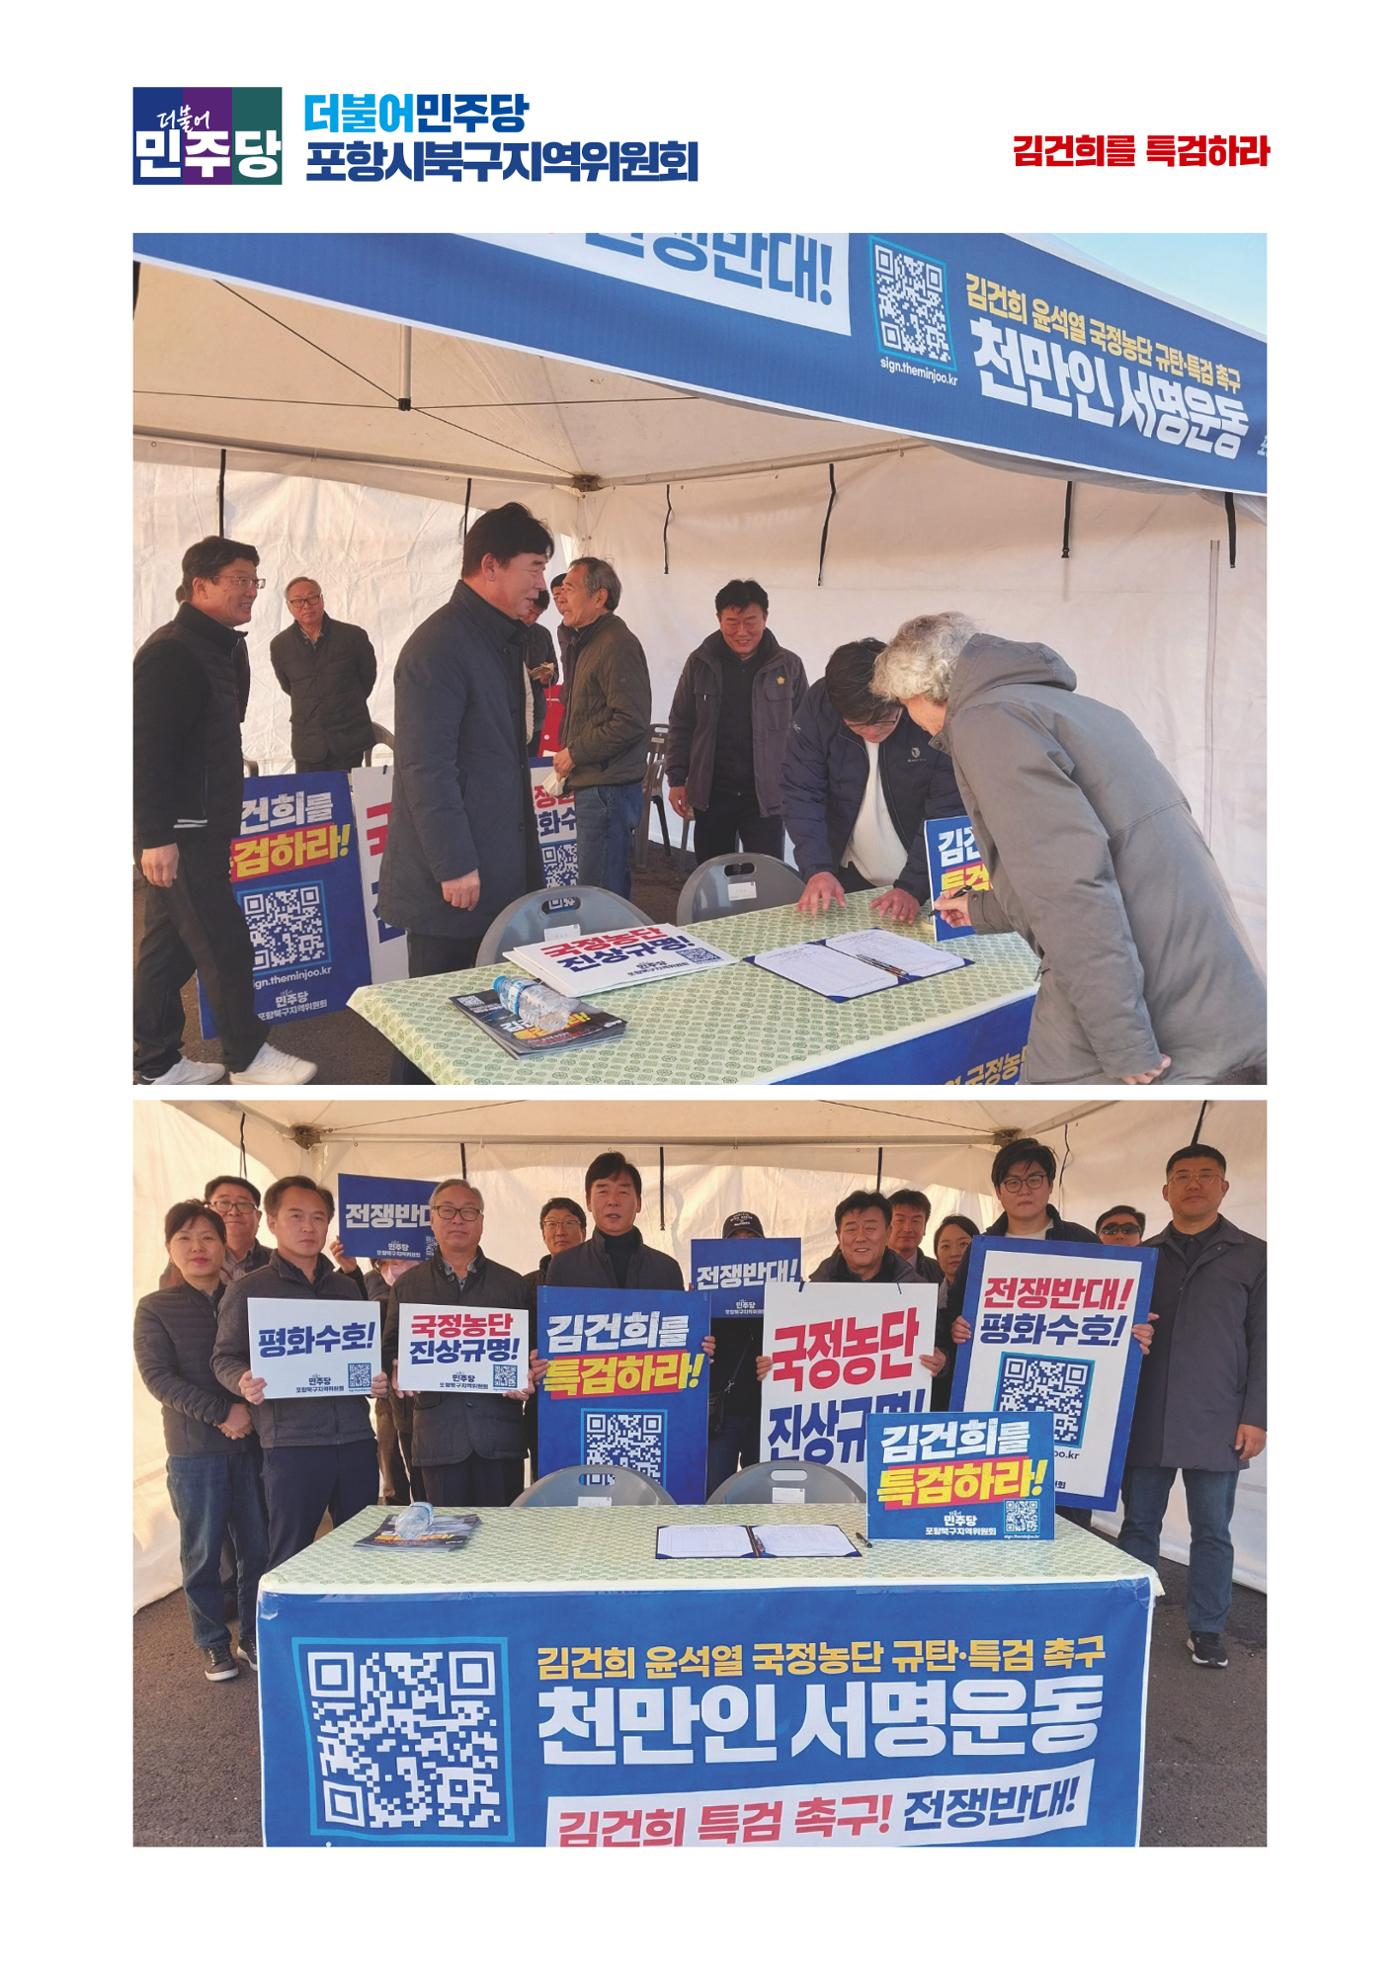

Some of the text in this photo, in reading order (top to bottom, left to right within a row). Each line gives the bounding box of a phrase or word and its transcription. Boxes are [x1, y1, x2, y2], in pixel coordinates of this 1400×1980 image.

[965, 272, 1241, 394] 김건희 윤석열 국정농단 규탄·특검 촉구
[880, 357, 959, 388] sign.theminjoo.kr
[969, 317, 1250, 460] 천만인 서명운동
[240, 791, 334, 836] 건희를
[229, 823, 351, 880] 검하라!
[937, 826, 982, 867] 김건
[541, 926, 668, 958] 국정농단
[556, 934, 696, 973] 진상규명!
[275, 990, 309, 1009] 민주당
[965, 1047, 1026, 1085] 국정농
[697, 1258, 799, 1291] 전쟁반대!
[983, 1277, 1135, 1310] 전쟁반대!
[258, 1321, 376, 1359] 평화수호!
[411, 1313, 513, 1338] 국정농단
[546, 1311, 689, 1353] 김건희를
[980, 1312, 1128, 1347] 평화수호!
[409, 1338, 520, 1365] 진상규명!
[771, 1307, 919, 1392] 국정농단
[543, 1352, 705, 1396] 특검하라!
[880, 1418, 1031, 1463] 김건희를
[876, 1459, 1049, 1506] 특검하라!
[943, 1515, 978, 1527] 민주당
[537, 1635, 1106, 1680] 김건희 윤석열 국정농단 규탄·특검 촉구
[538, 1675, 1104, 1765] 천만인 서명운동
[559, 1776, 1080, 1847] 김건희 특검 촉구! 전쟁반대!
